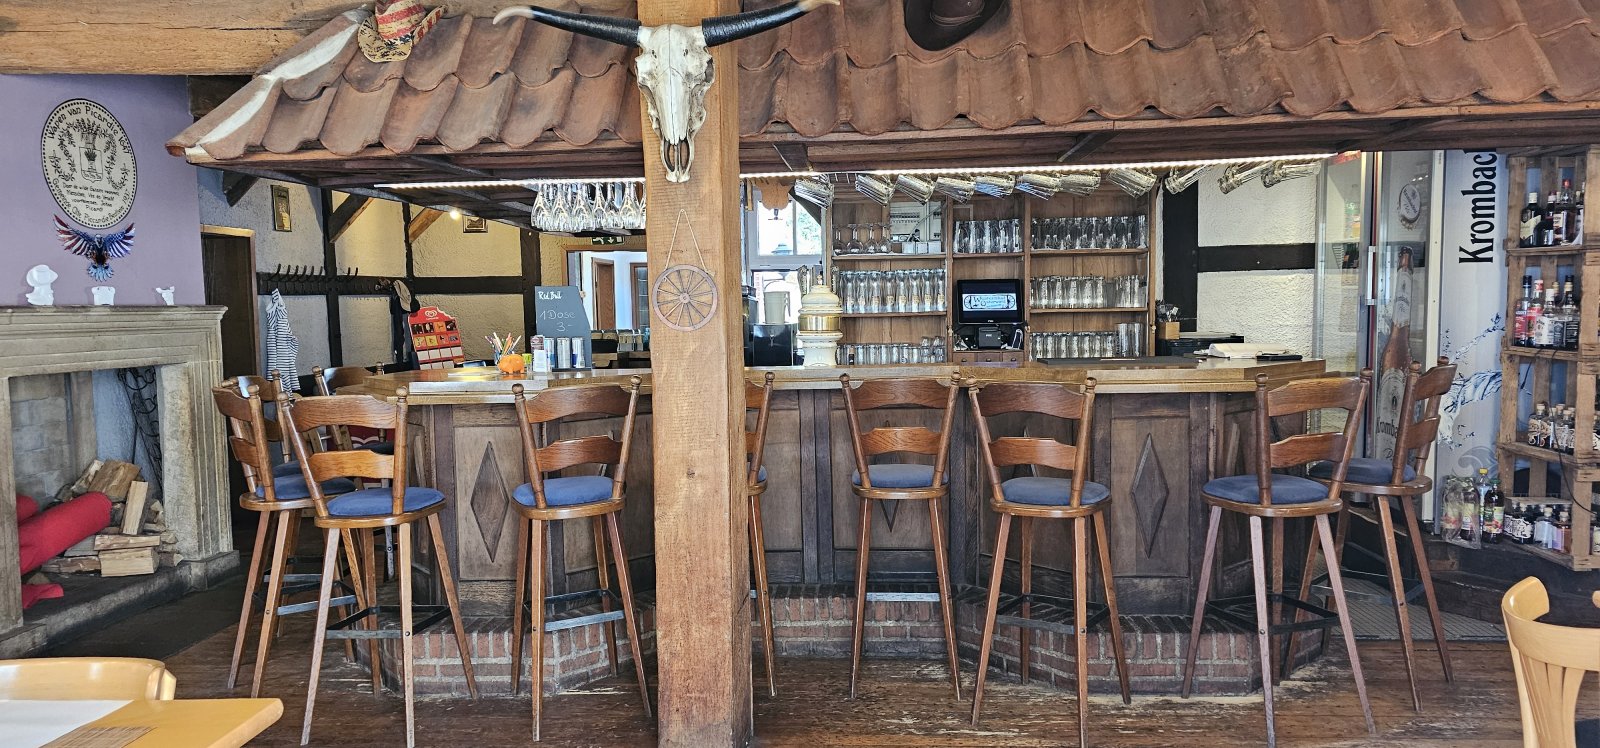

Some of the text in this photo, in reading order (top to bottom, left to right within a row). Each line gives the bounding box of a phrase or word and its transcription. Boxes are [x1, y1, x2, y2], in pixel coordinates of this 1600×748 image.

[68, 108, 81, 116] van
[85, 105, 119, 136] Picardie
[538, 291, 550, 300] Red
[540, 310, 575, 320] 1 Dose
